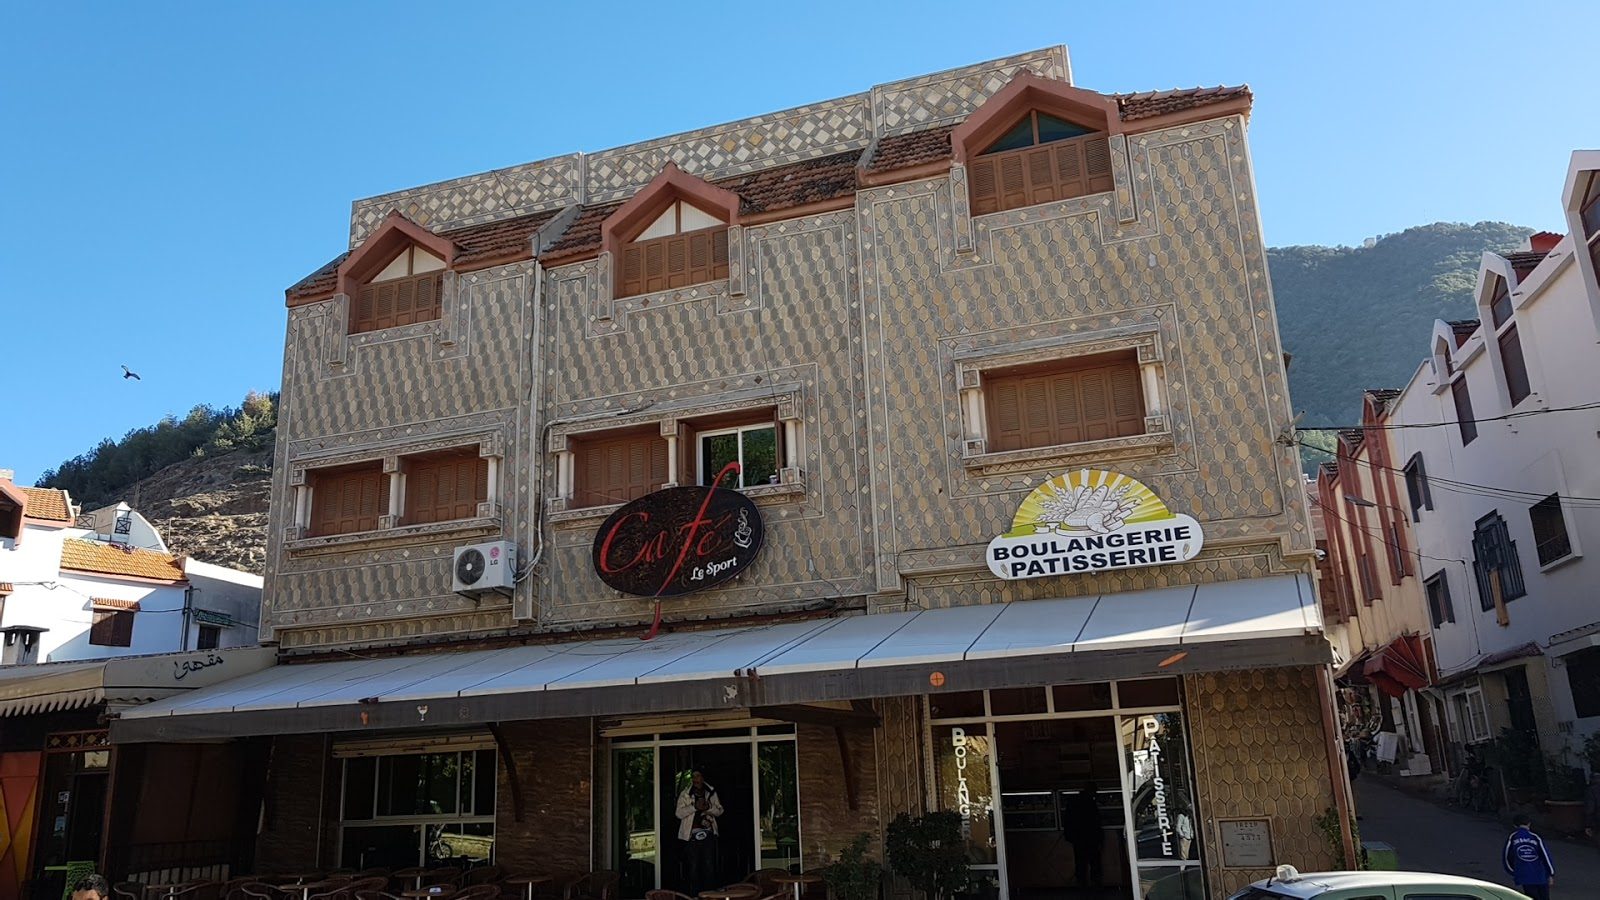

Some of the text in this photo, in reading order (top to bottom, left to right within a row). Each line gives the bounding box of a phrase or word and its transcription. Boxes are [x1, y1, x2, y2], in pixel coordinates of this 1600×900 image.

[993, 525, 1191, 561] BOULANGERIE
[690, 556, 737, 580] Le Sport
[1011, 545, 1177, 577] PATISSERIE
